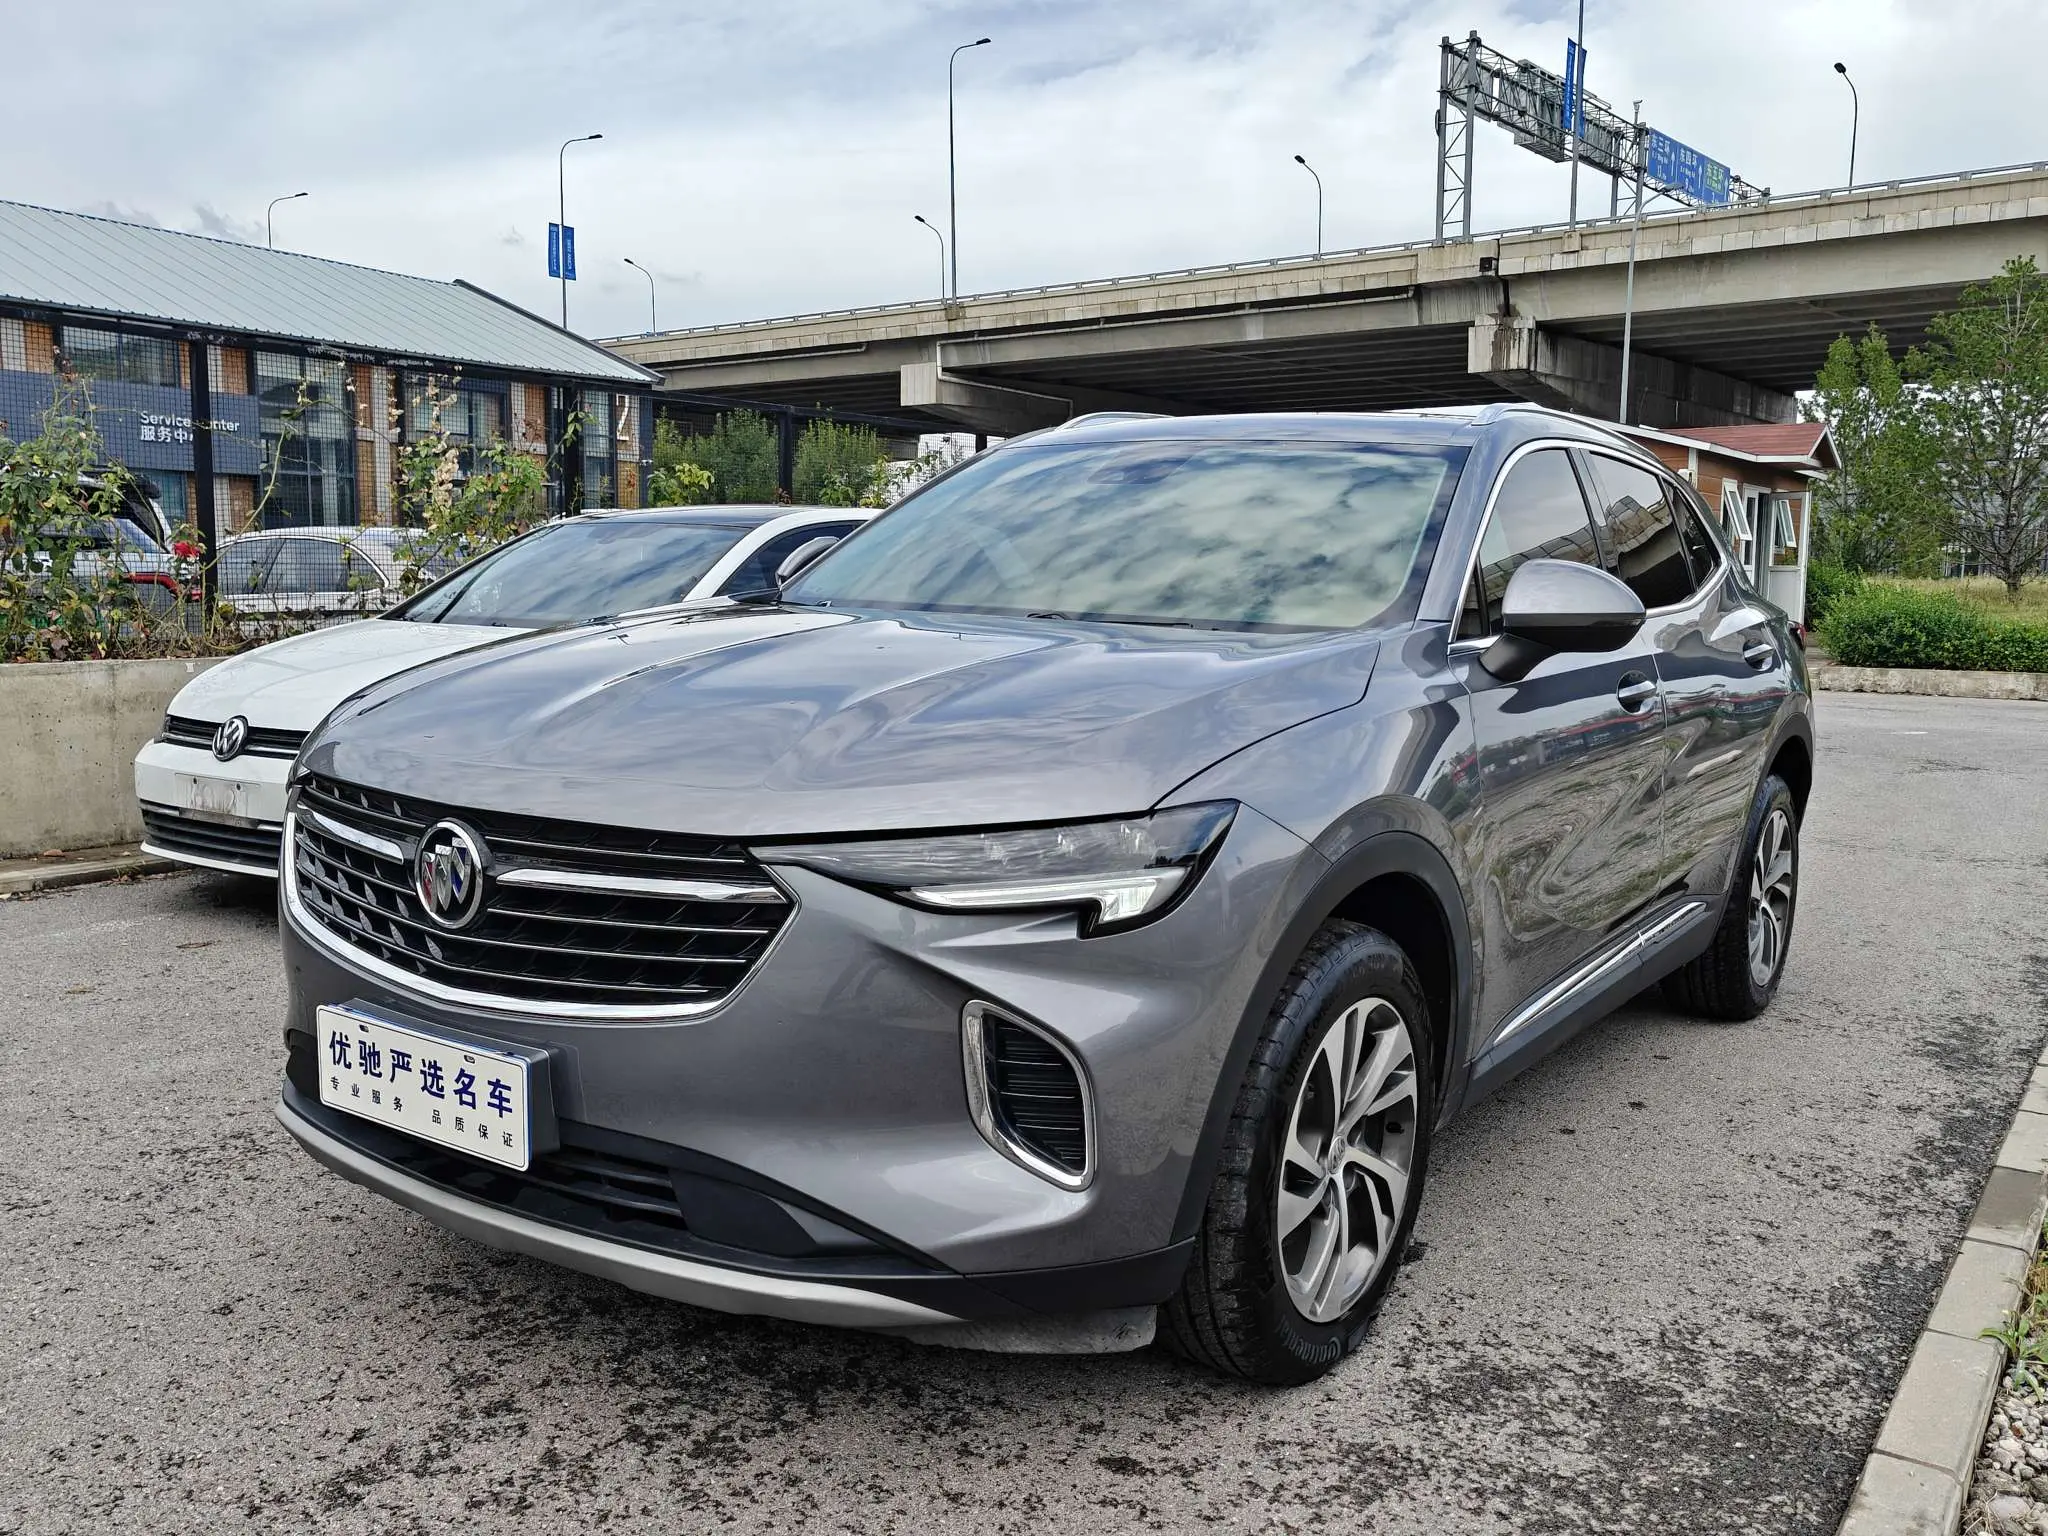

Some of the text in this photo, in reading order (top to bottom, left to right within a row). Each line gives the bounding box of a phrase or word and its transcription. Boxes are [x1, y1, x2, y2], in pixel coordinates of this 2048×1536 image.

[140, 410, 192, 428] Service
[140, 425, 193, 444] 服务中
[328, 1030, 514, 1119] 优驰严选名车
[330, 1075, 514, 1149] 专业服务 品质保证
